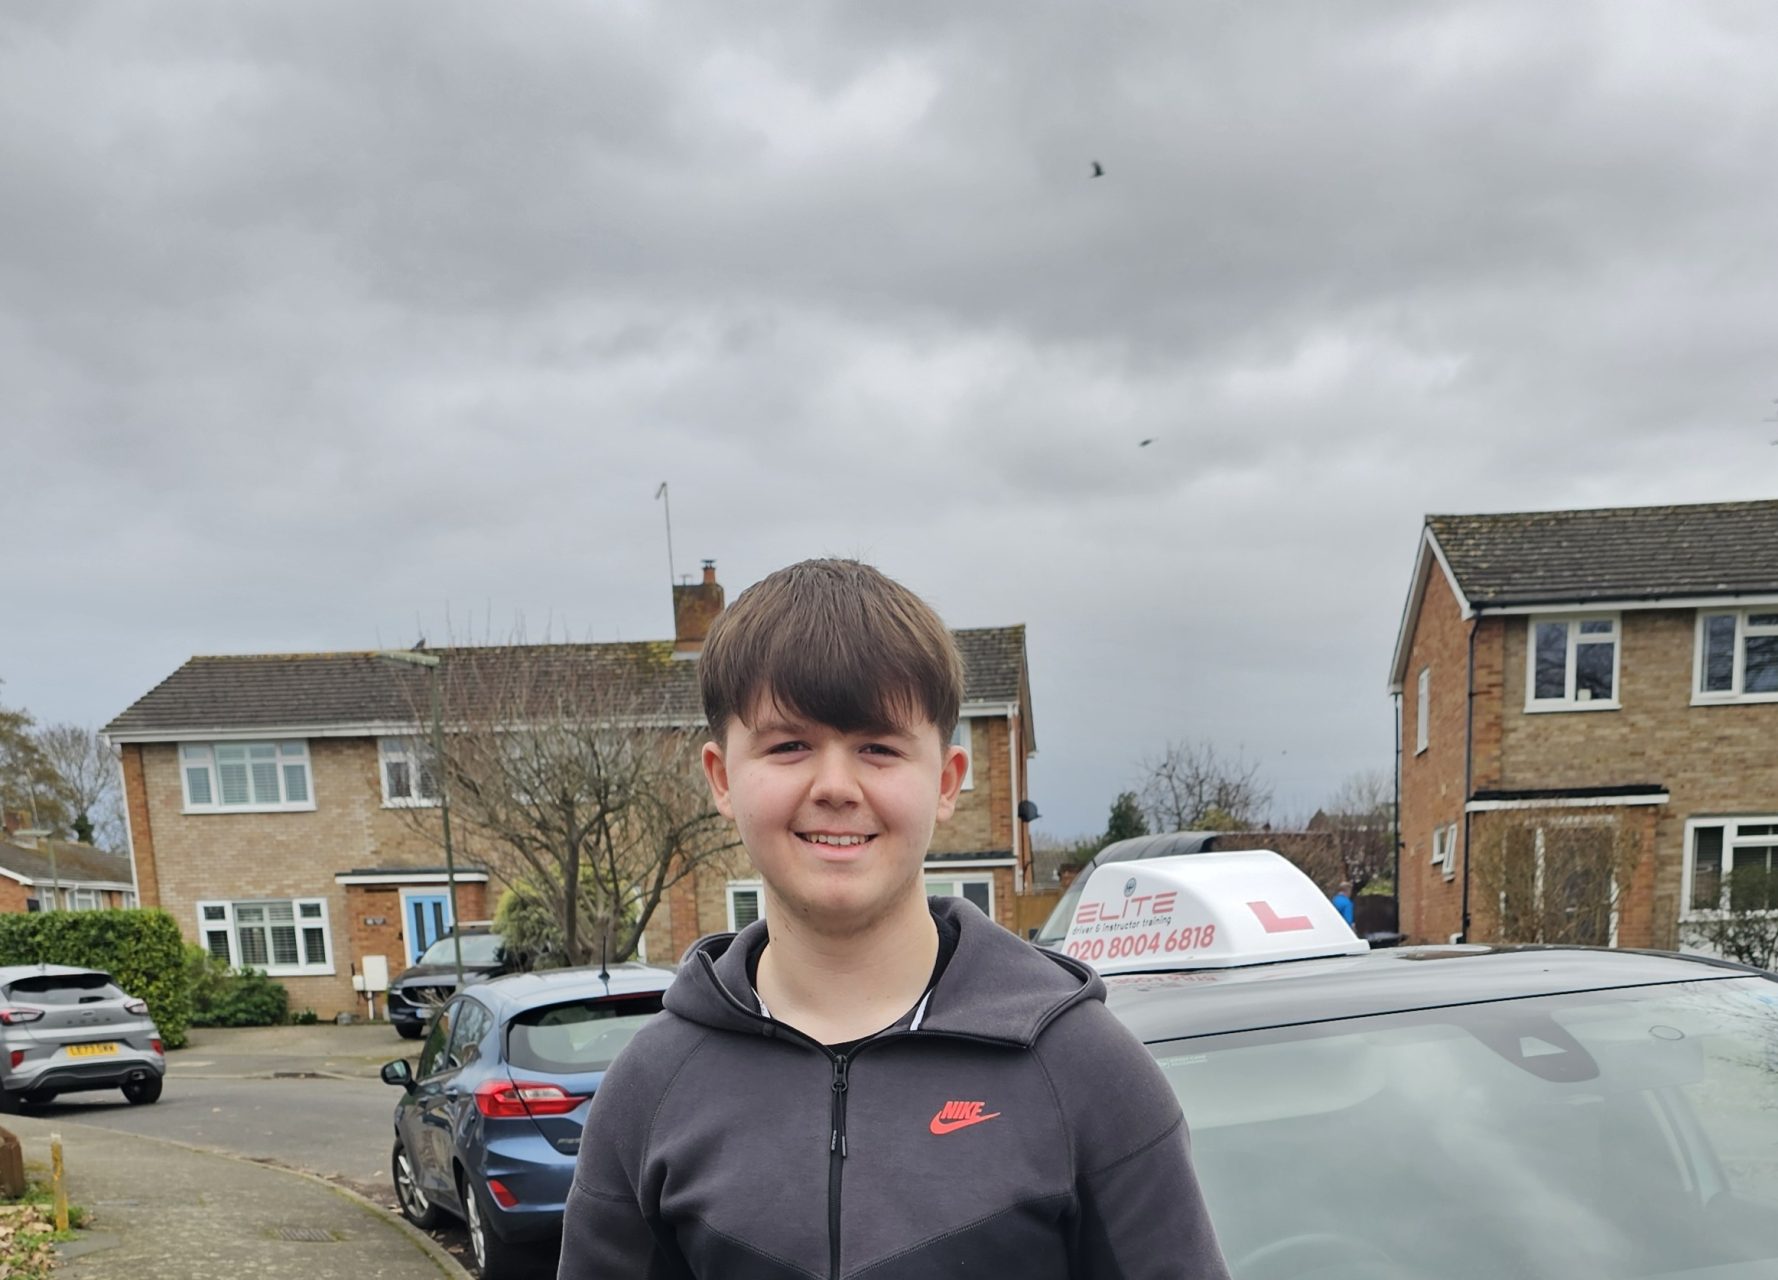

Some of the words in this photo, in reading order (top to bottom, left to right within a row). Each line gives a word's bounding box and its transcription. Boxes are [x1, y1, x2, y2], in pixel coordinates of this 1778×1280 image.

[1075, 891, 1178, 924] ELITE
[1246, 900, 1315, 934] L
[1067, 938, 1105, 960] 020
[1107, 931, 1162, 959] 8004
[1164, 924, 1216, 953] 6818
[1072, 924, 1094, 936] driver
[1102, 919, 1140, 933] instructor
[1142, 915, 1172, 927] training
[940, 1100, 986, 1120] NIKE
